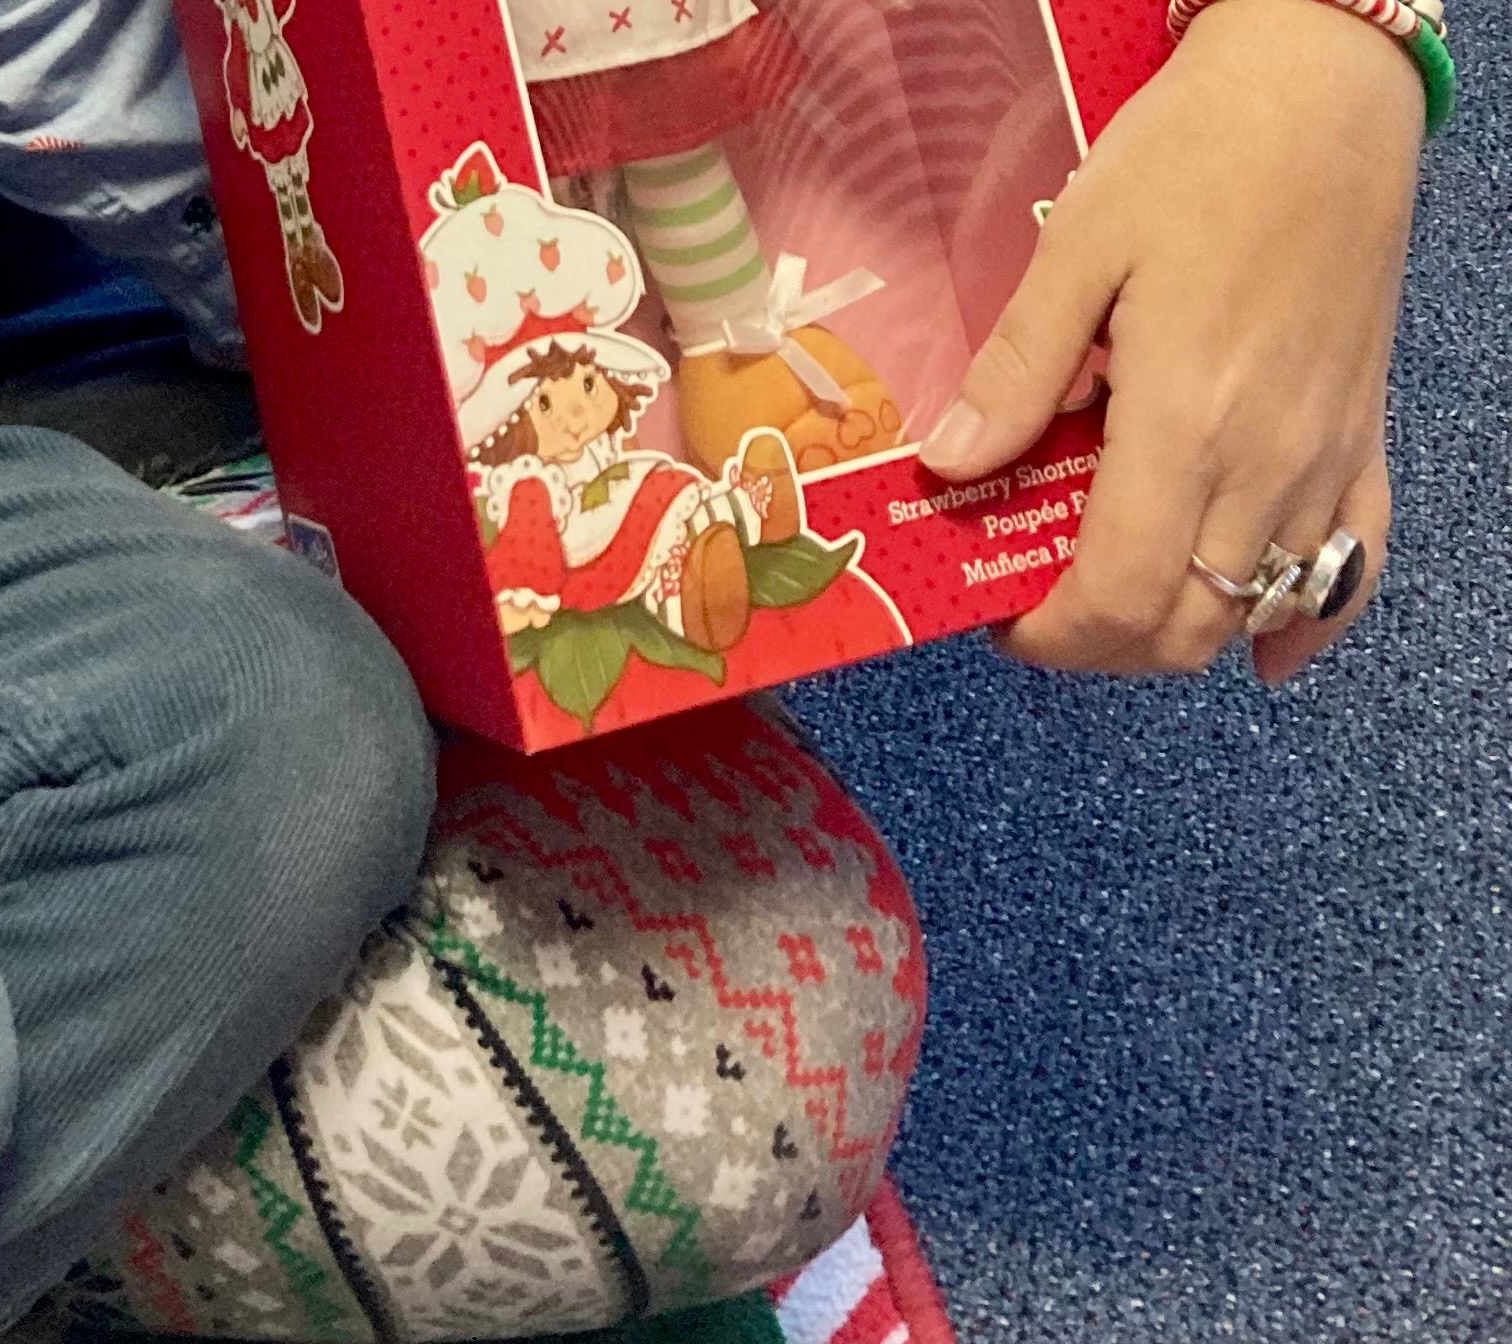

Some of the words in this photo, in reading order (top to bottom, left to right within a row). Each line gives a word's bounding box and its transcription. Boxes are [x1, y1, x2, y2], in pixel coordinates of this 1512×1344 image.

[887, 473, 1012, 528] Strawberry
[1015, 444, 1105, 492] Shortca
[982, 496, 1070, 540] Poupée
[960, 543, 1054, 588] Muñeca
